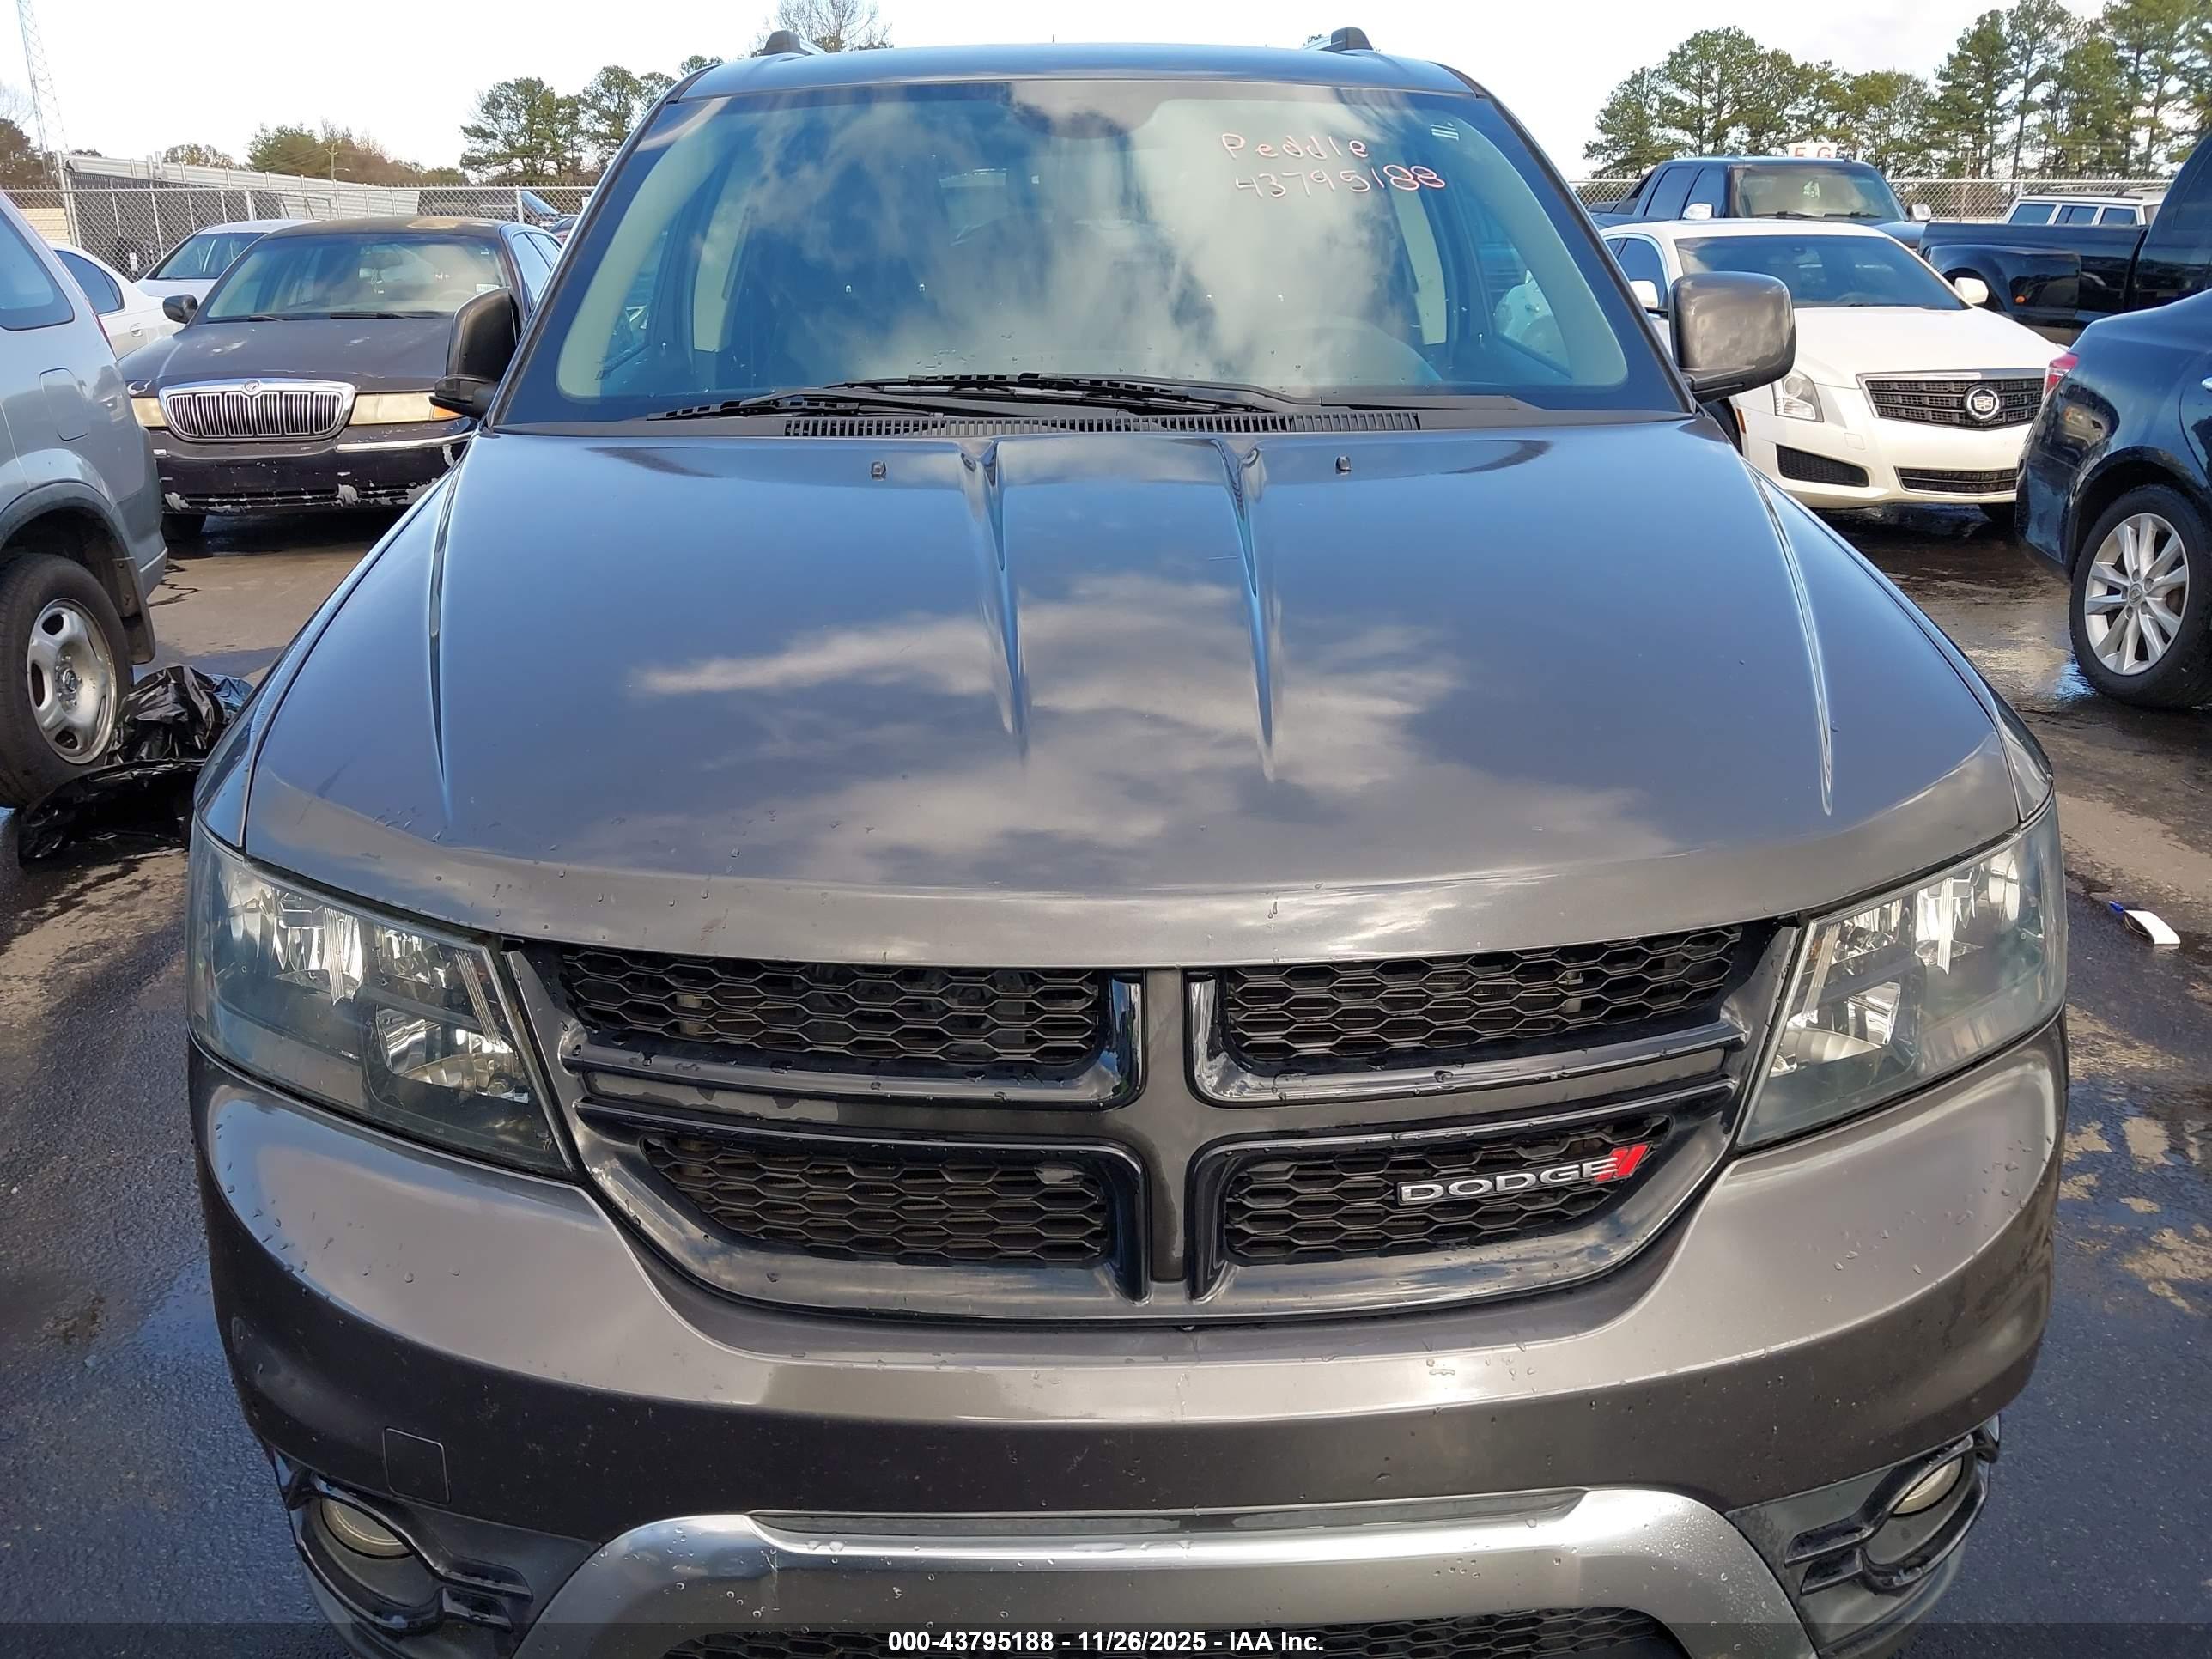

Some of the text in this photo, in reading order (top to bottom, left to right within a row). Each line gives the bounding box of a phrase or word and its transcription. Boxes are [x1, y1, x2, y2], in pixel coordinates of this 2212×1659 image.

[1221, 133, 1369, 160] Peddle
[1235, 164, 1446, 198] 43795188
[1401, 1157, 1619, 1201] DODGE
